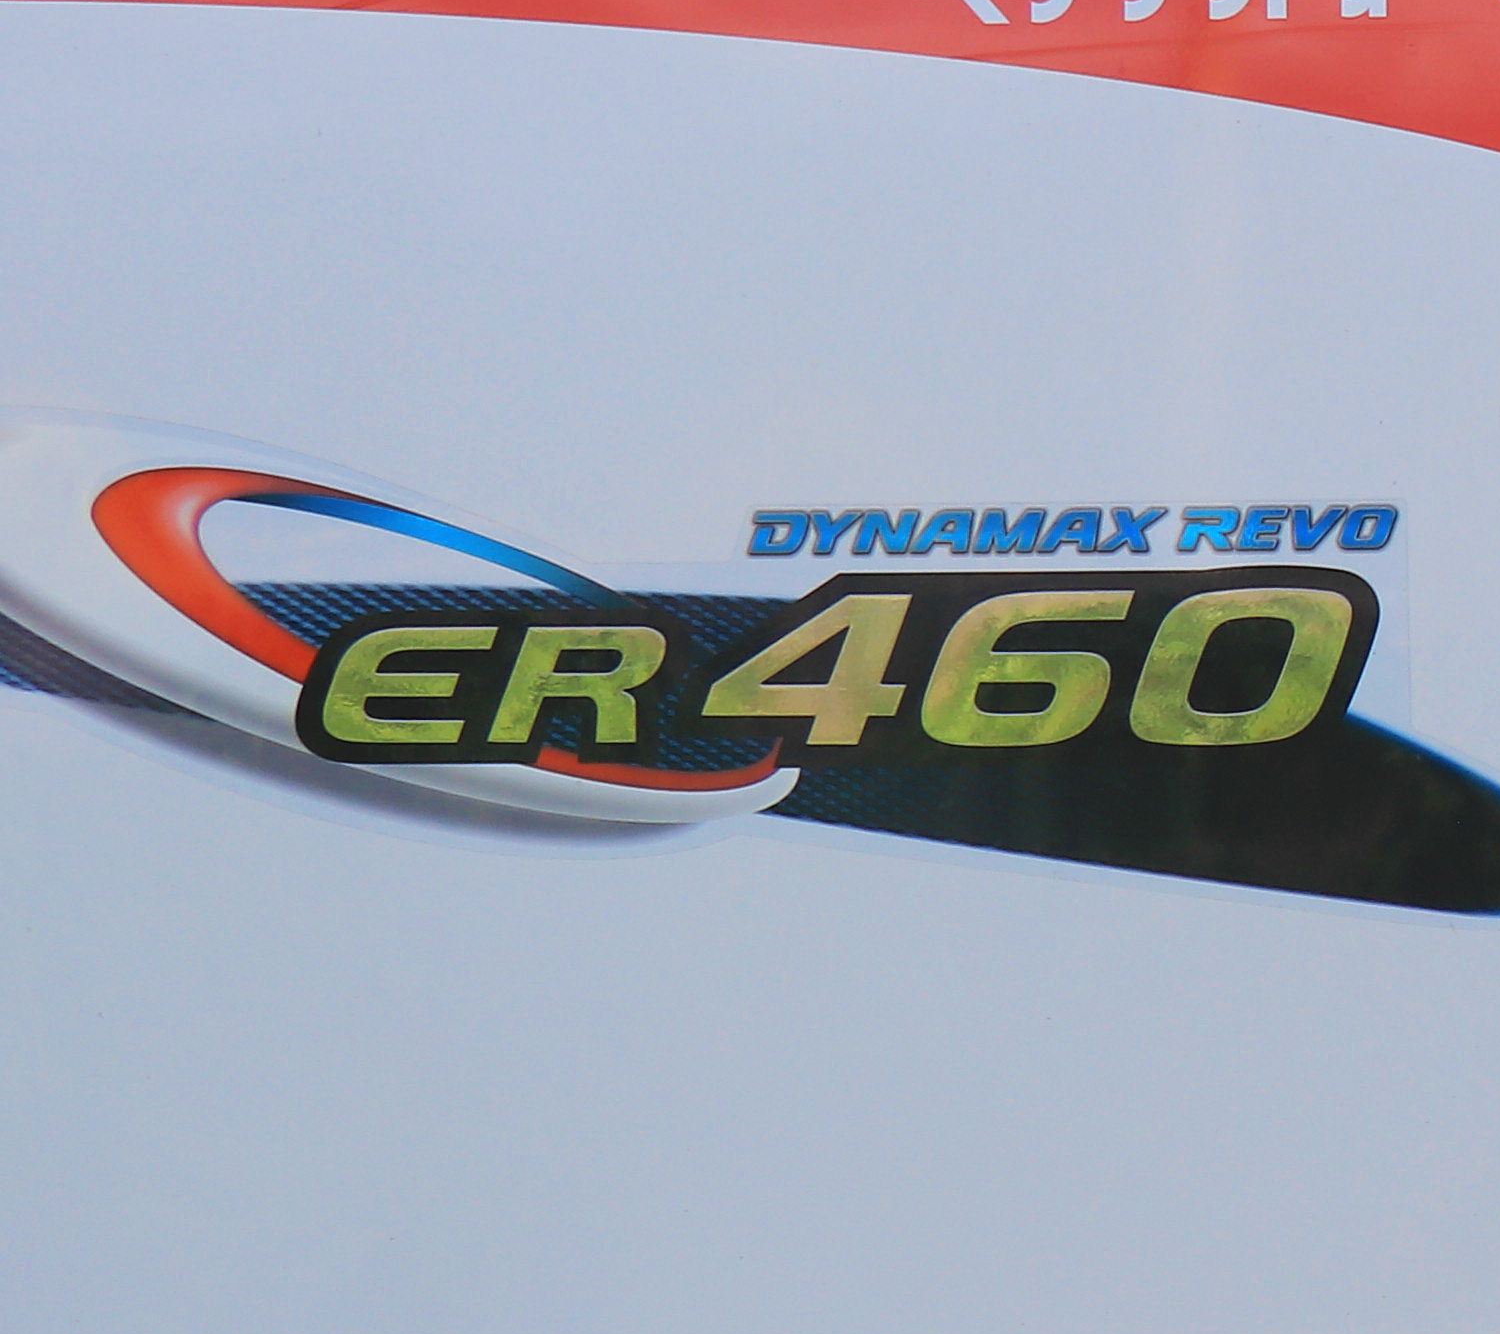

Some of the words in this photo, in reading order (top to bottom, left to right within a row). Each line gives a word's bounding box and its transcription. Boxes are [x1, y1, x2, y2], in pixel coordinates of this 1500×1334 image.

[746, 506, 1169, 556] DYNAMAX
[1176, 504, 1399, 552] REVO
[321, 624, 666, 745] ER
[701, 587, 1354, 747] 460
